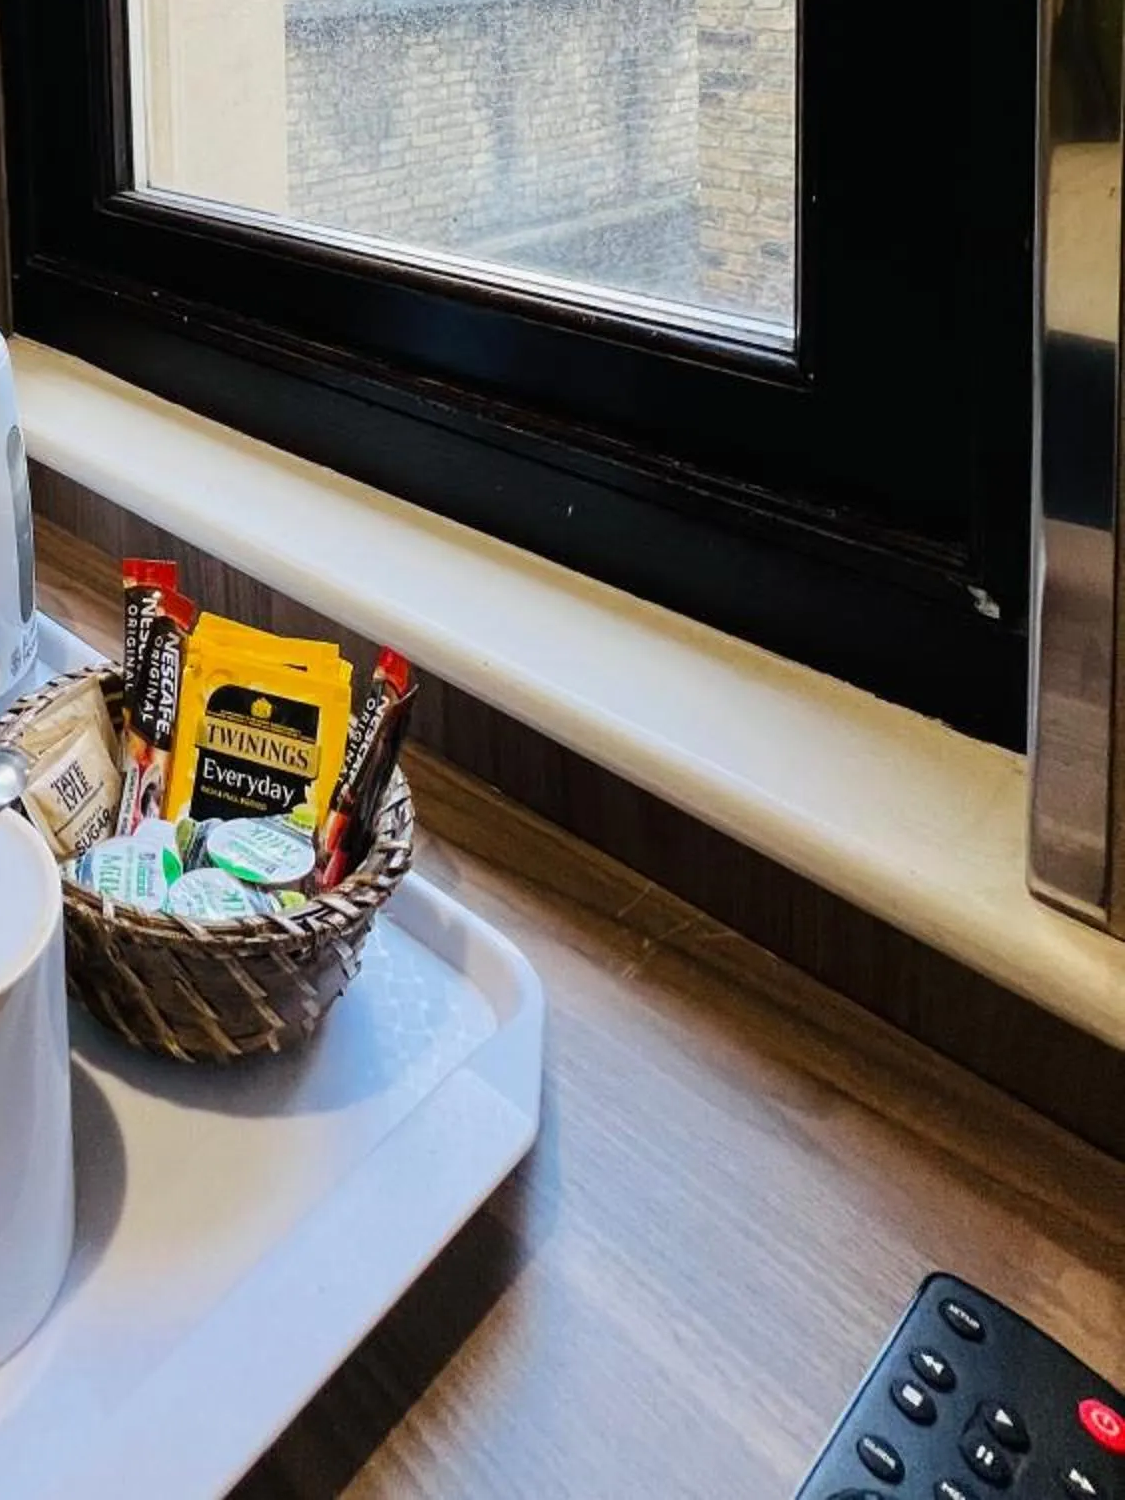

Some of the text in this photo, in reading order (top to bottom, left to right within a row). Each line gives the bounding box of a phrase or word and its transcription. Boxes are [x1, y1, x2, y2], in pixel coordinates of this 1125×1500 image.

[124, 603, 139, 692] ORIGINAL
[142, 635, 164, 724] ORIGINAL
[206, 722, 310, 769] TWININGS
[202, 757, 295, 808] Everyday
[74, 808, 110, 857] SUGAR
